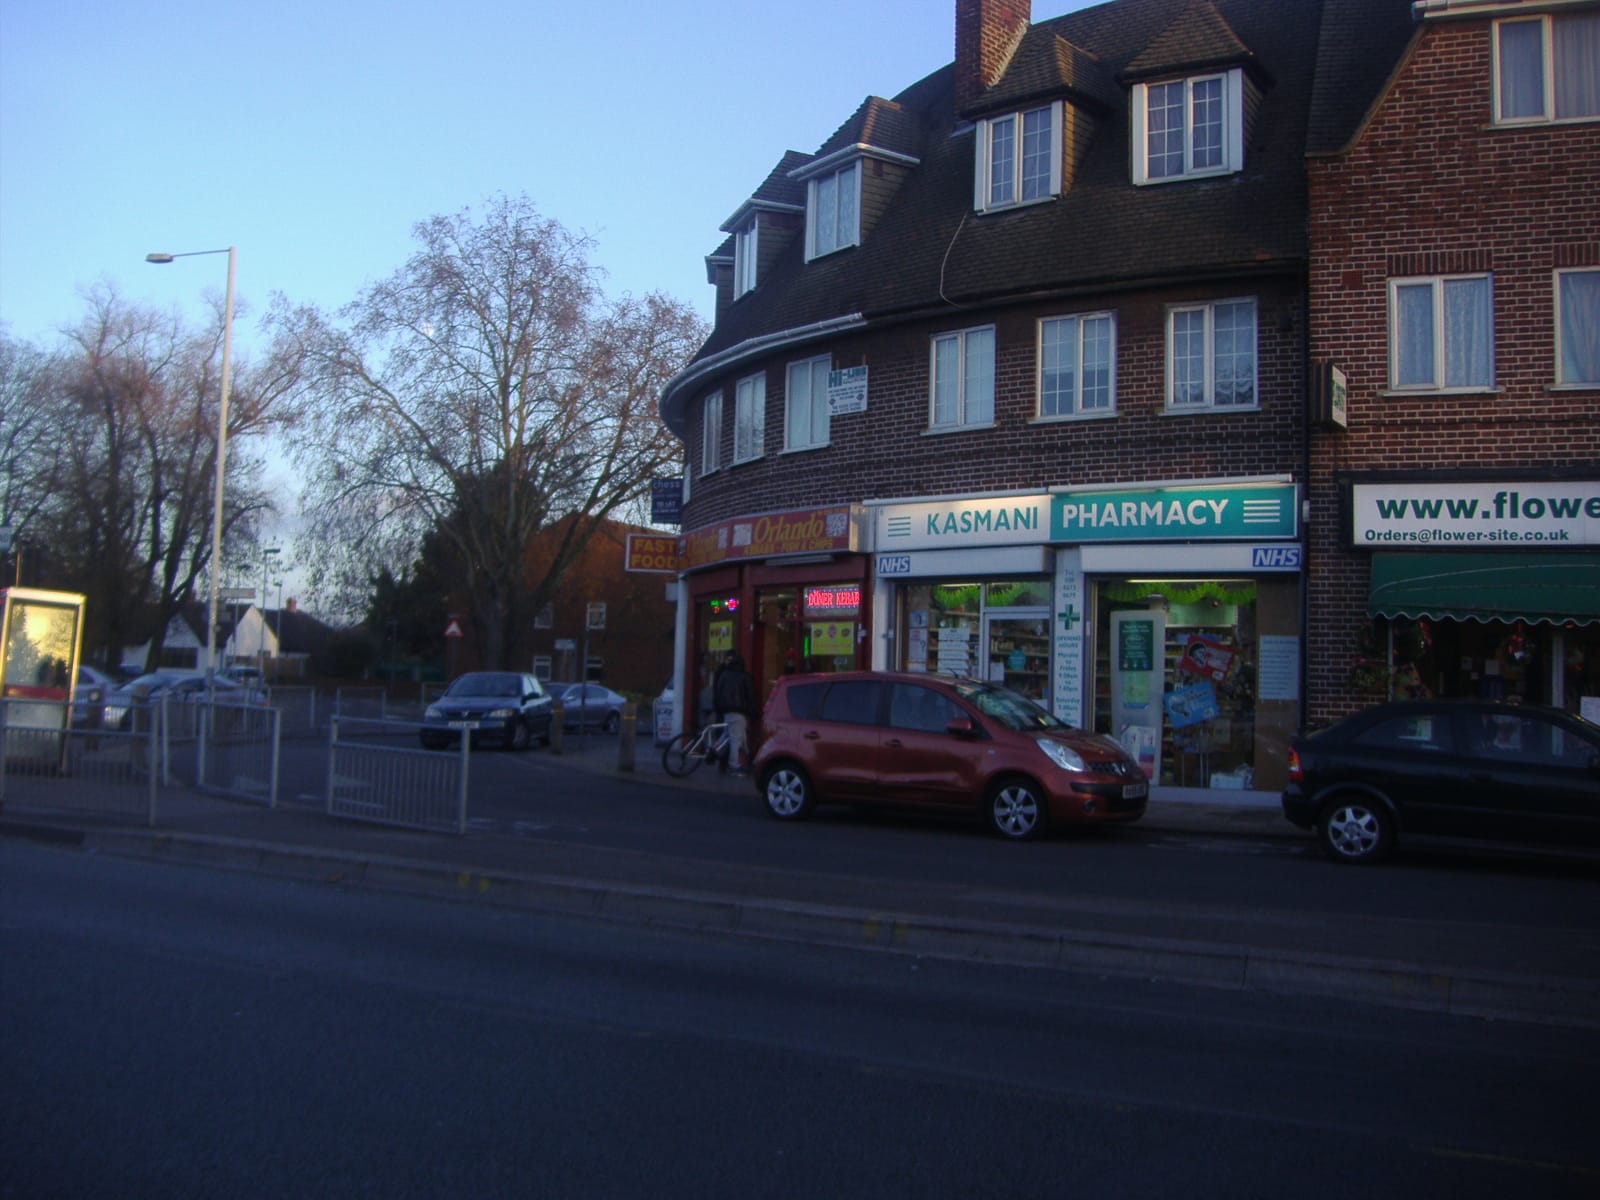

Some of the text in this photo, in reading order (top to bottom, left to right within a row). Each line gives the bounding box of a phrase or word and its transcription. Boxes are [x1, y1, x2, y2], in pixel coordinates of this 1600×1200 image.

[926, 506, 1038, 535] KASMANI
[1062, 499, 1229, 528] PHARMACY
[754, 514, 824, 543] Orlando
[1365, 529, 1569, 543] Orders@flower-site.co.uk
[634, 538, 676, 553] FAST
[880, 557, 909, 573] NHS
[1254, 549, 1298, 566] NHS
[836, 591, 861, 606] KEBAB
